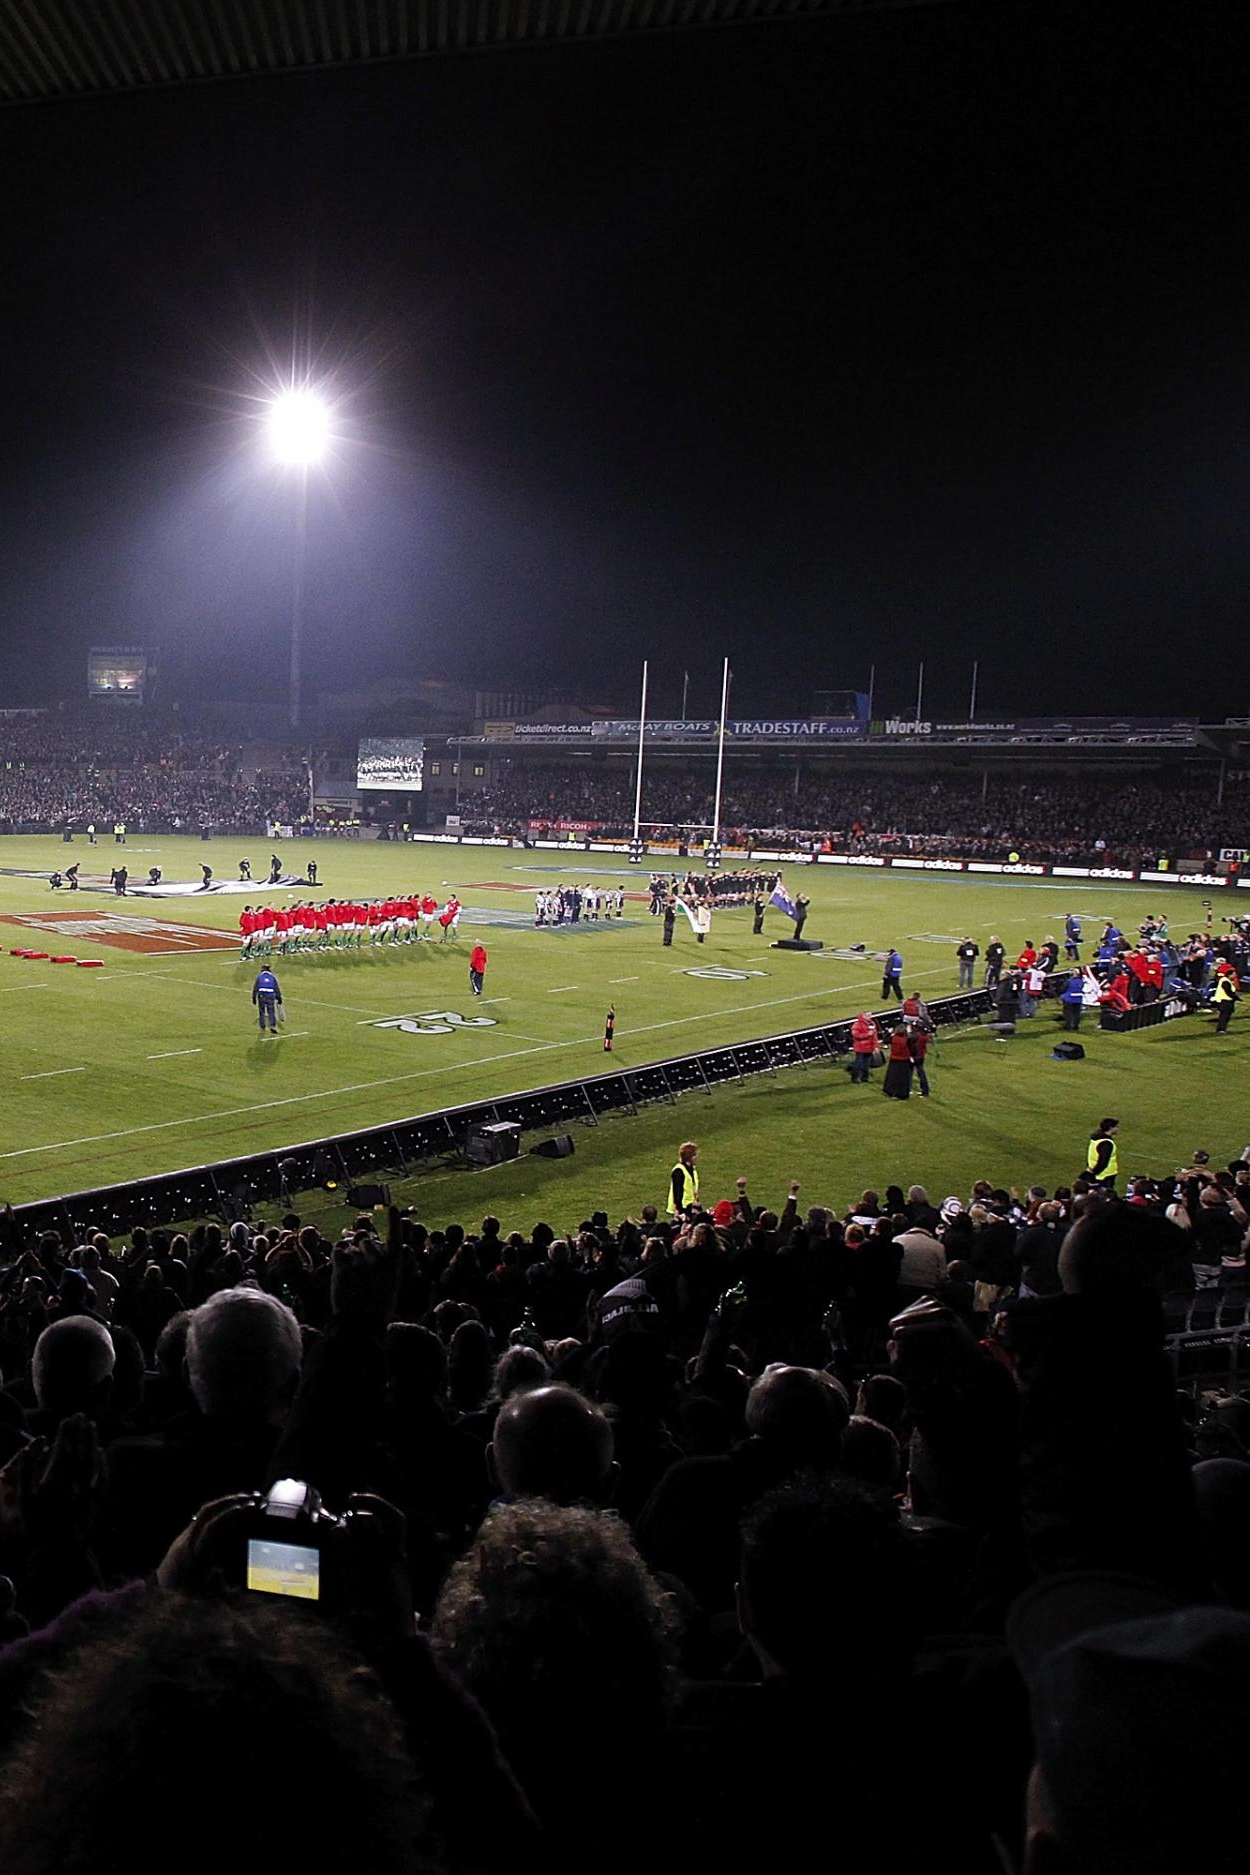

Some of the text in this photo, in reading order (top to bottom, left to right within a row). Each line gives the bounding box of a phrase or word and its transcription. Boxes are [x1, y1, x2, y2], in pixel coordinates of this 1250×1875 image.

[515, 723, 593, 734] ticketdirect.co.nz
[664, 723, 710, 731] BOATS
[885, 720, 932, 734] Works
[560, 822, 588, 830] RICOH
[557, 840, 586, 850] adidas
[778, 852, 813, 862] adidas
[848, 854, 884, 866] adidas
[924, 860, 963, 870] adidas
[1002, 864, 1044, 874] adidas
[1089, 868, 1134, 879] adidas
[1180, 874, 1227, 886] adidas
[370, 1011, 500, 1035] 22
